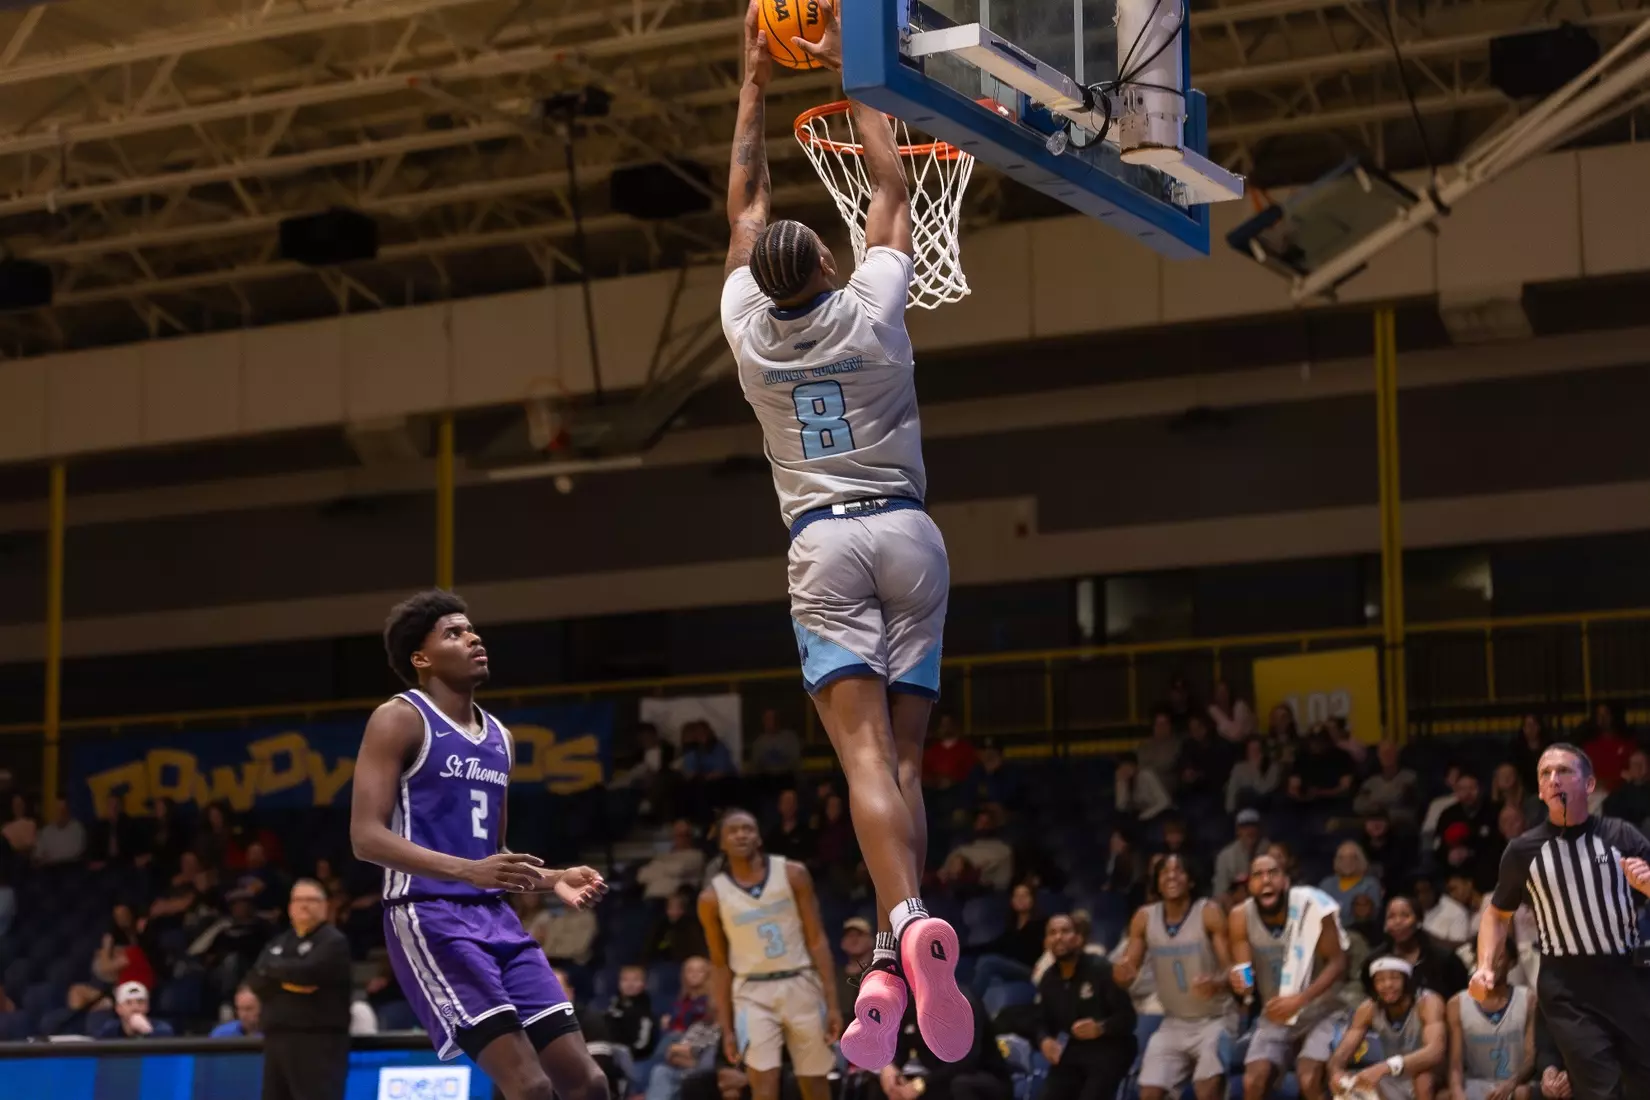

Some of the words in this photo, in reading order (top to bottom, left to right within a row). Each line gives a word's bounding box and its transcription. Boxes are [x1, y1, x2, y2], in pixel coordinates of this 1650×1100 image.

[792, 380, 856, 460] 8
[470, 789, 488, 840] 2
[757, 922, 787, 959] 3
